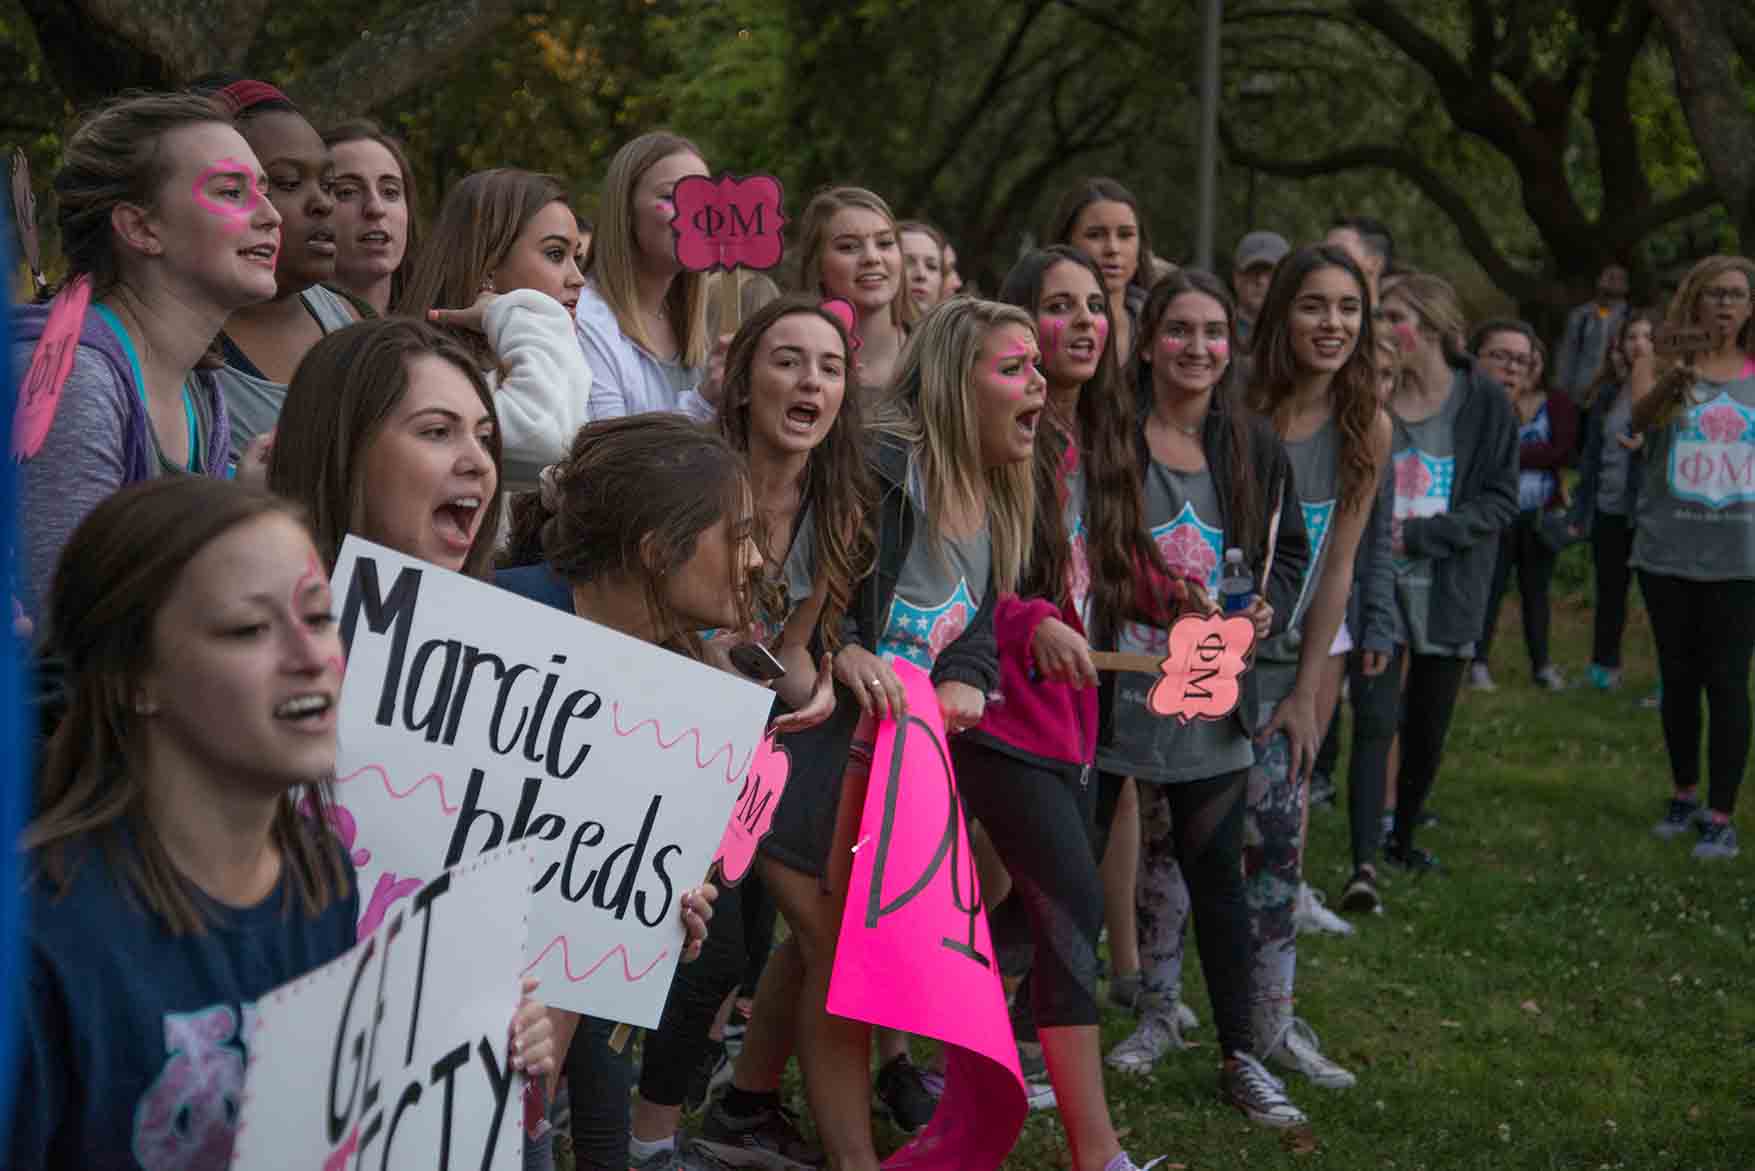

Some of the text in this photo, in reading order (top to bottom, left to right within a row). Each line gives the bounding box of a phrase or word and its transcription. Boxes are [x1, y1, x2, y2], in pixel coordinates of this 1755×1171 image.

[692, 202, 764, 237] ΦM
[338, 556, 602, 780] Marcie
[736, 774, 774, 834] M
[326, 869, 452, 1146] GET
